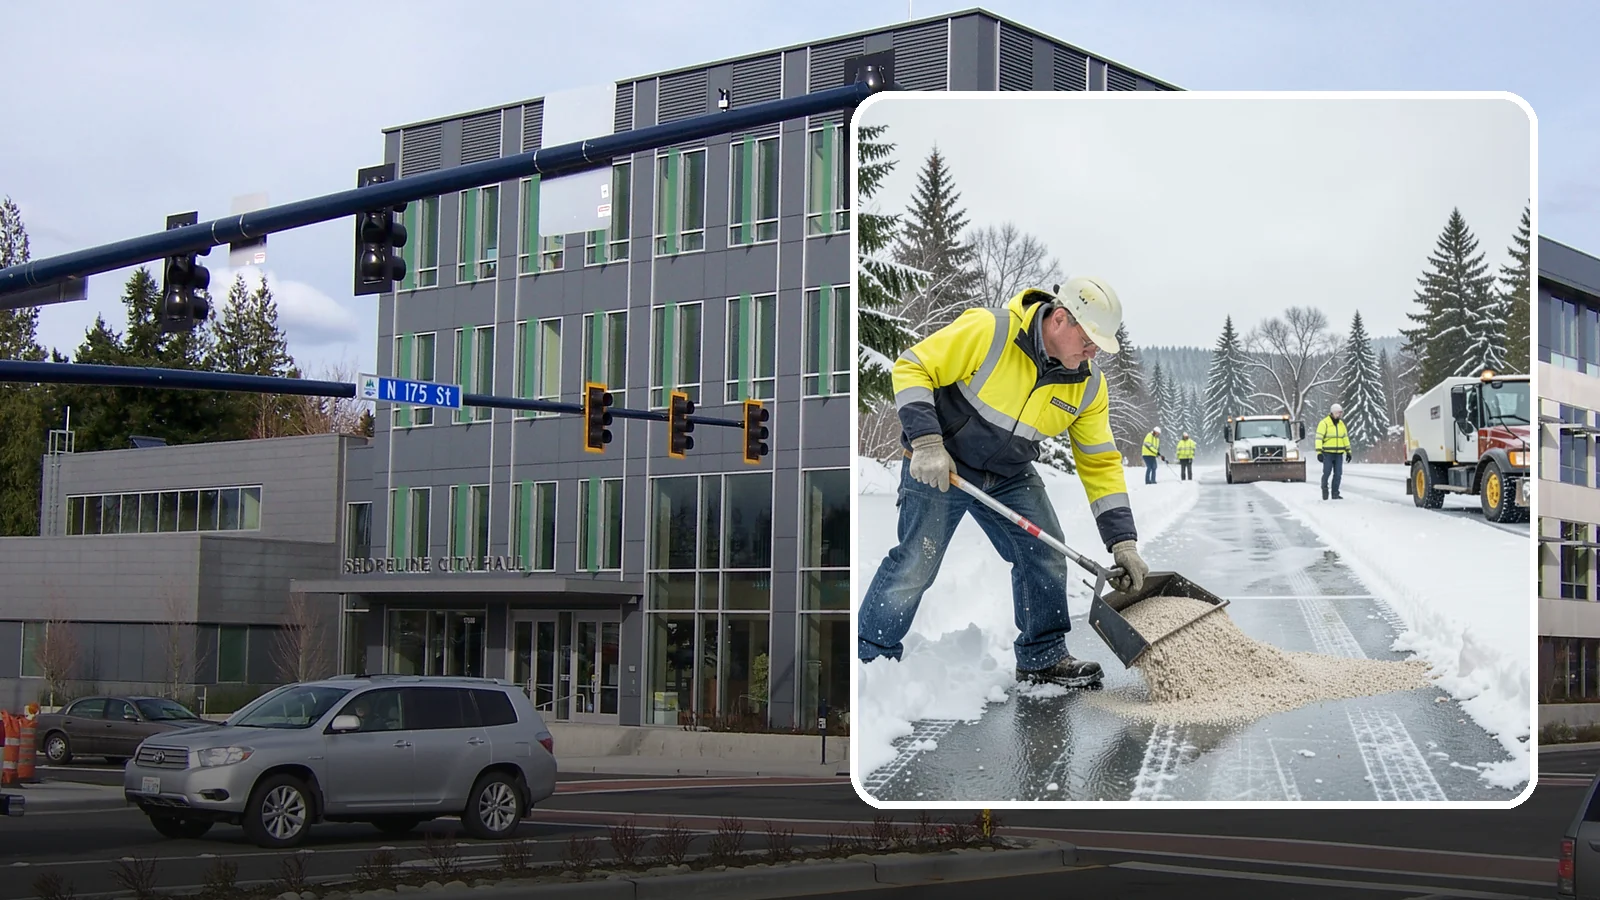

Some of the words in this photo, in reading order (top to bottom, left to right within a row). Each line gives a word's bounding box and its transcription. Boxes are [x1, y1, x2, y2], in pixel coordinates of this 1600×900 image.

[387, 380, 396, 400] N
[405, 382, 428, 403] 175
[436, 386, 452, 406] St
[343, 557, 432, 574] SHORELINE
[438, 556, 476, 573] CITY
[484, 555, 525, 572] HALL
